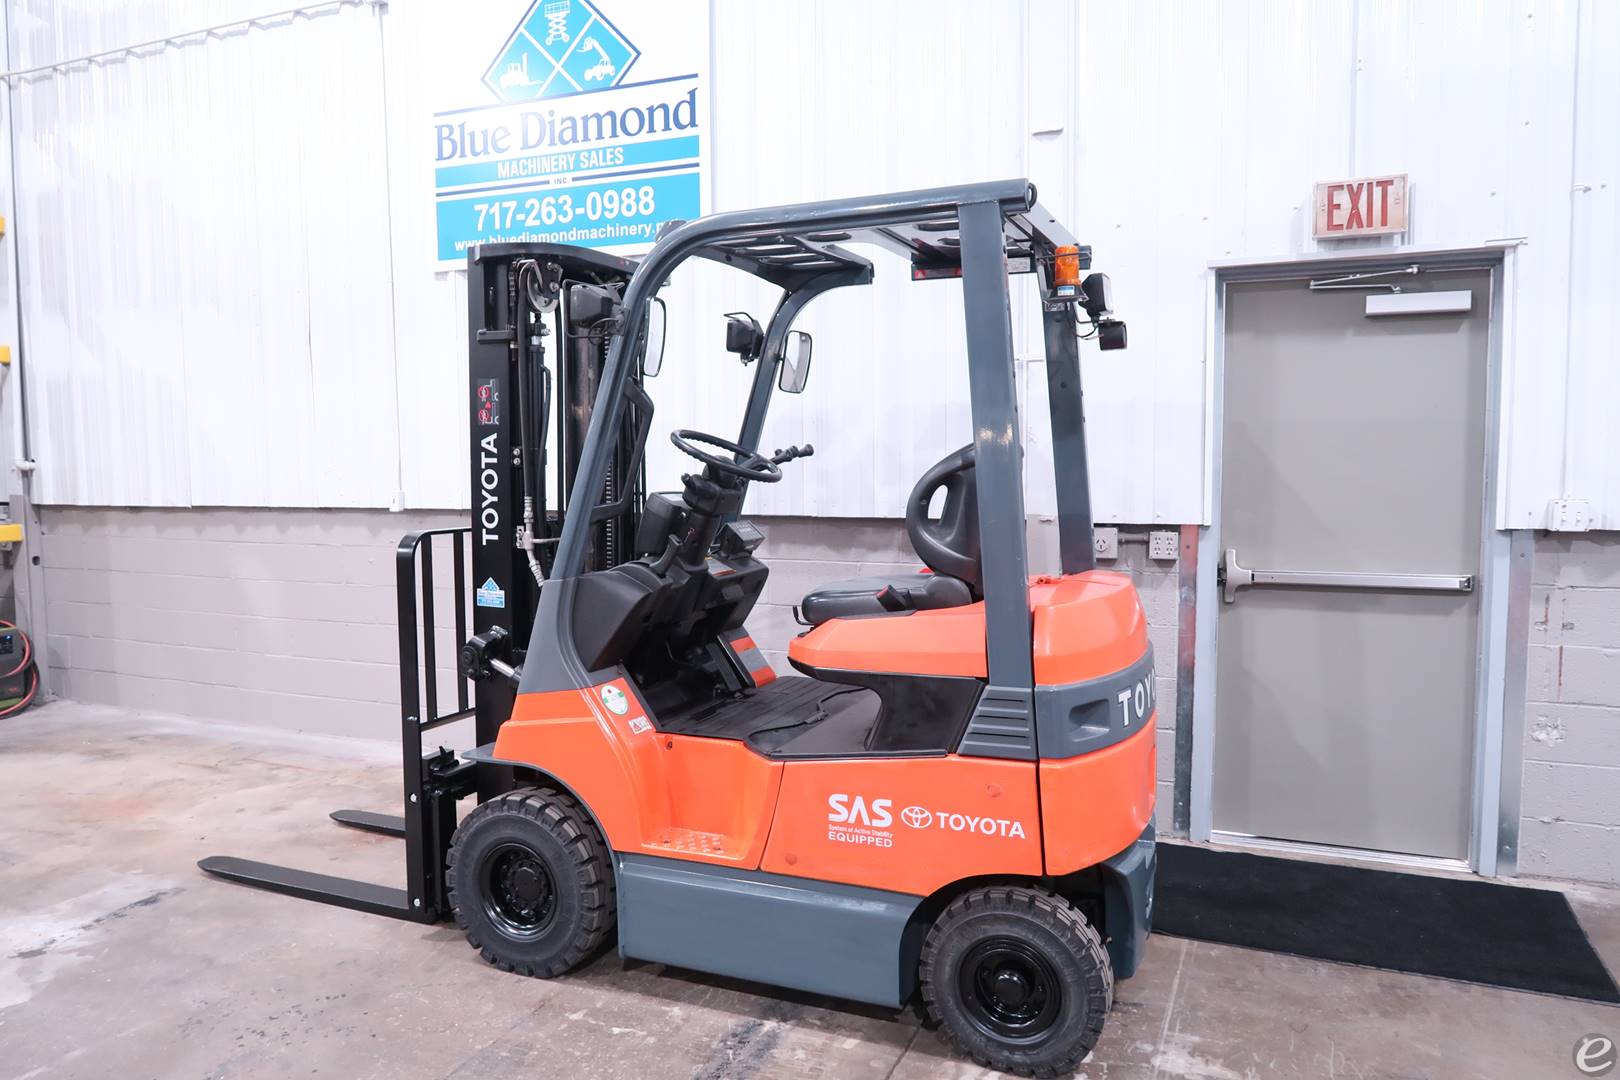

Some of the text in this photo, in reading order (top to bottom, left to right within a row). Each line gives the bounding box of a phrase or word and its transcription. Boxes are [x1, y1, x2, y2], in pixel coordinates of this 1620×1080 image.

[434, 87, 699, 161] Blue Diamond
[497, 147, 624, 179] MACHINERY SALES
[473, 185, 656, 233] 717-263-0988
[1326, 179, 1394, 231] EXIT
[480, 432, 500, 546] TOYOTA
[828, 793, 893, 828] SAS
[935, 811, 1026, 840] TOYOTA
[828, 831, 893, 848] EQUIPPED
